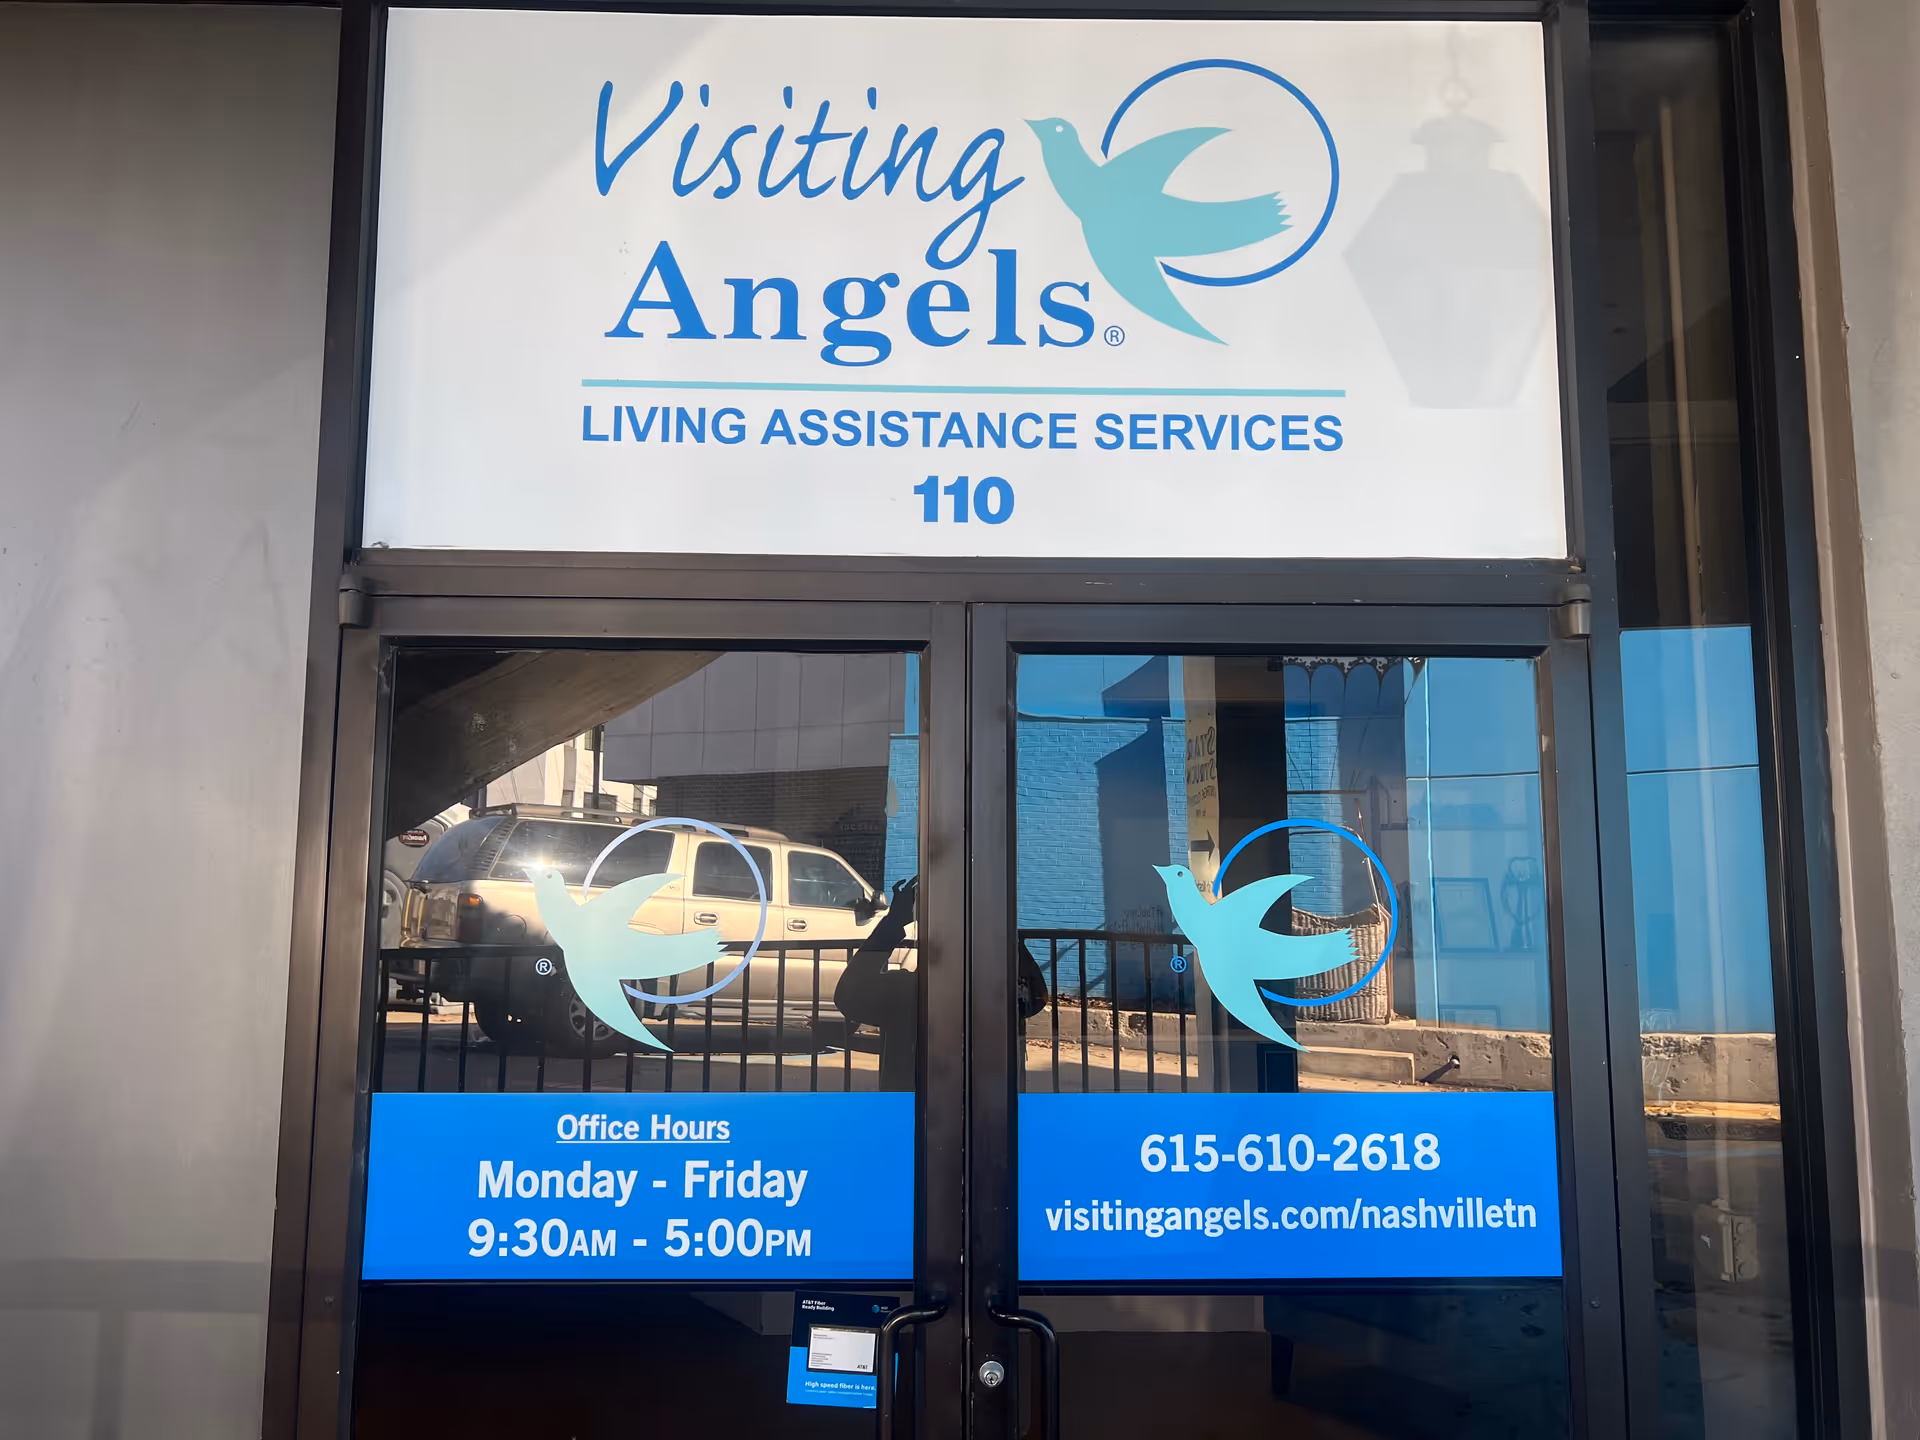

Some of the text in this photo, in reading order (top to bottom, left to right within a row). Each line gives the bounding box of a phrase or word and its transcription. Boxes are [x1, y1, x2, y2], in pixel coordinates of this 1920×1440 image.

[594, 80, 1026, 270] Visiting
[604, 241, 1096, 367] Angels
[582, 405, 1344, 453] LIVING ASSISTANCE SERVICES
[913, 475, 1015, 525] 110
[556, 1114, 731, 1141] Office Hours
[1140, 1132, 1441, 1173] 615-610-2618
[477, 1160, 639, 1207] Monday
[684, 1159, 809, 1207] Friday
[467, 1217, 617, 1258] 9:30AM
[664, 1217, 812, 1258] 5:00PM
[1045, 1197, 1537, 1238] visitingangels.com/nashvilletn
[805, 1381, 819, 1390] High
[820, 1382, 838, 1390] speed
[839, 1382, 854, 1390] fiber
